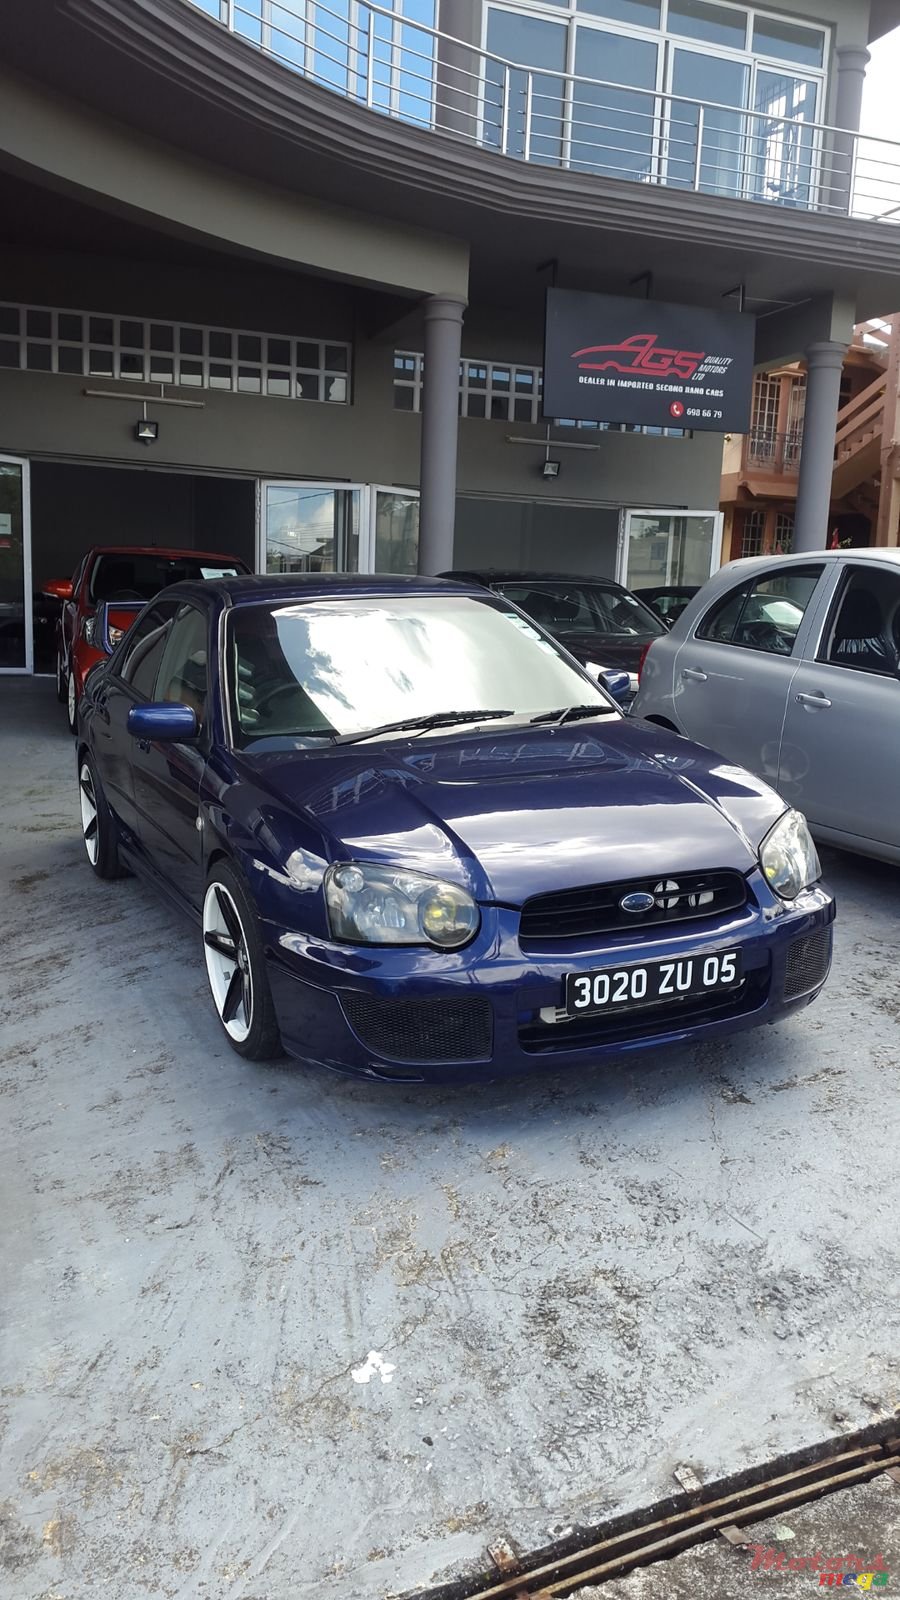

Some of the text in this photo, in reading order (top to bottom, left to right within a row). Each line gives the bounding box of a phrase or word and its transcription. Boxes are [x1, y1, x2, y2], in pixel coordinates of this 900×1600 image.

[704, 355, 734, 365] QUALITY
[697, 364, 728, 374] MOTORS
[691, 373, 705, 381] LTD
[578, 376, 606, 386] DEALER
[607, 378, 616, 387] IN
[617, 379, 654, 390] IMPORTED
[656, 383, 684, 393] SECOND
[705, 389, 724, 397] CARS
[713, 410, 722, 419] 79
[574, 953, 737, 1008] 3020 ZU 05
